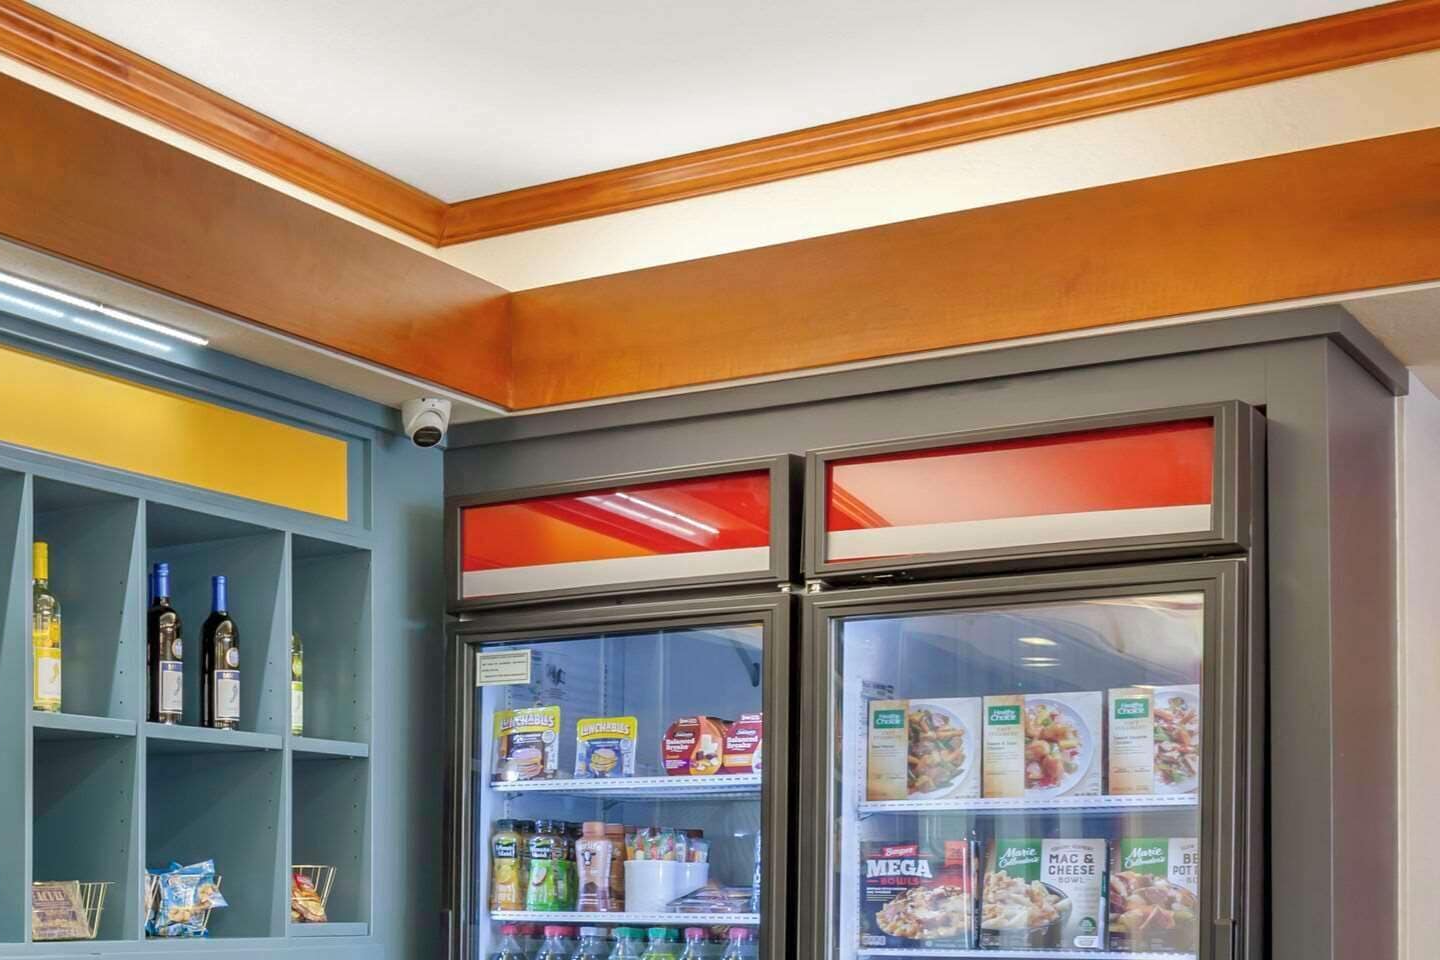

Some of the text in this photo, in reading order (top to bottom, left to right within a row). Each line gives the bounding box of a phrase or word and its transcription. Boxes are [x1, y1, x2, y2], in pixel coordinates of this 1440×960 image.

[1049, 854, 1094, 864] MAC &
[866, 859, 933, 879] MEGA
[1048, 865, 1096, 875] CHEESE
